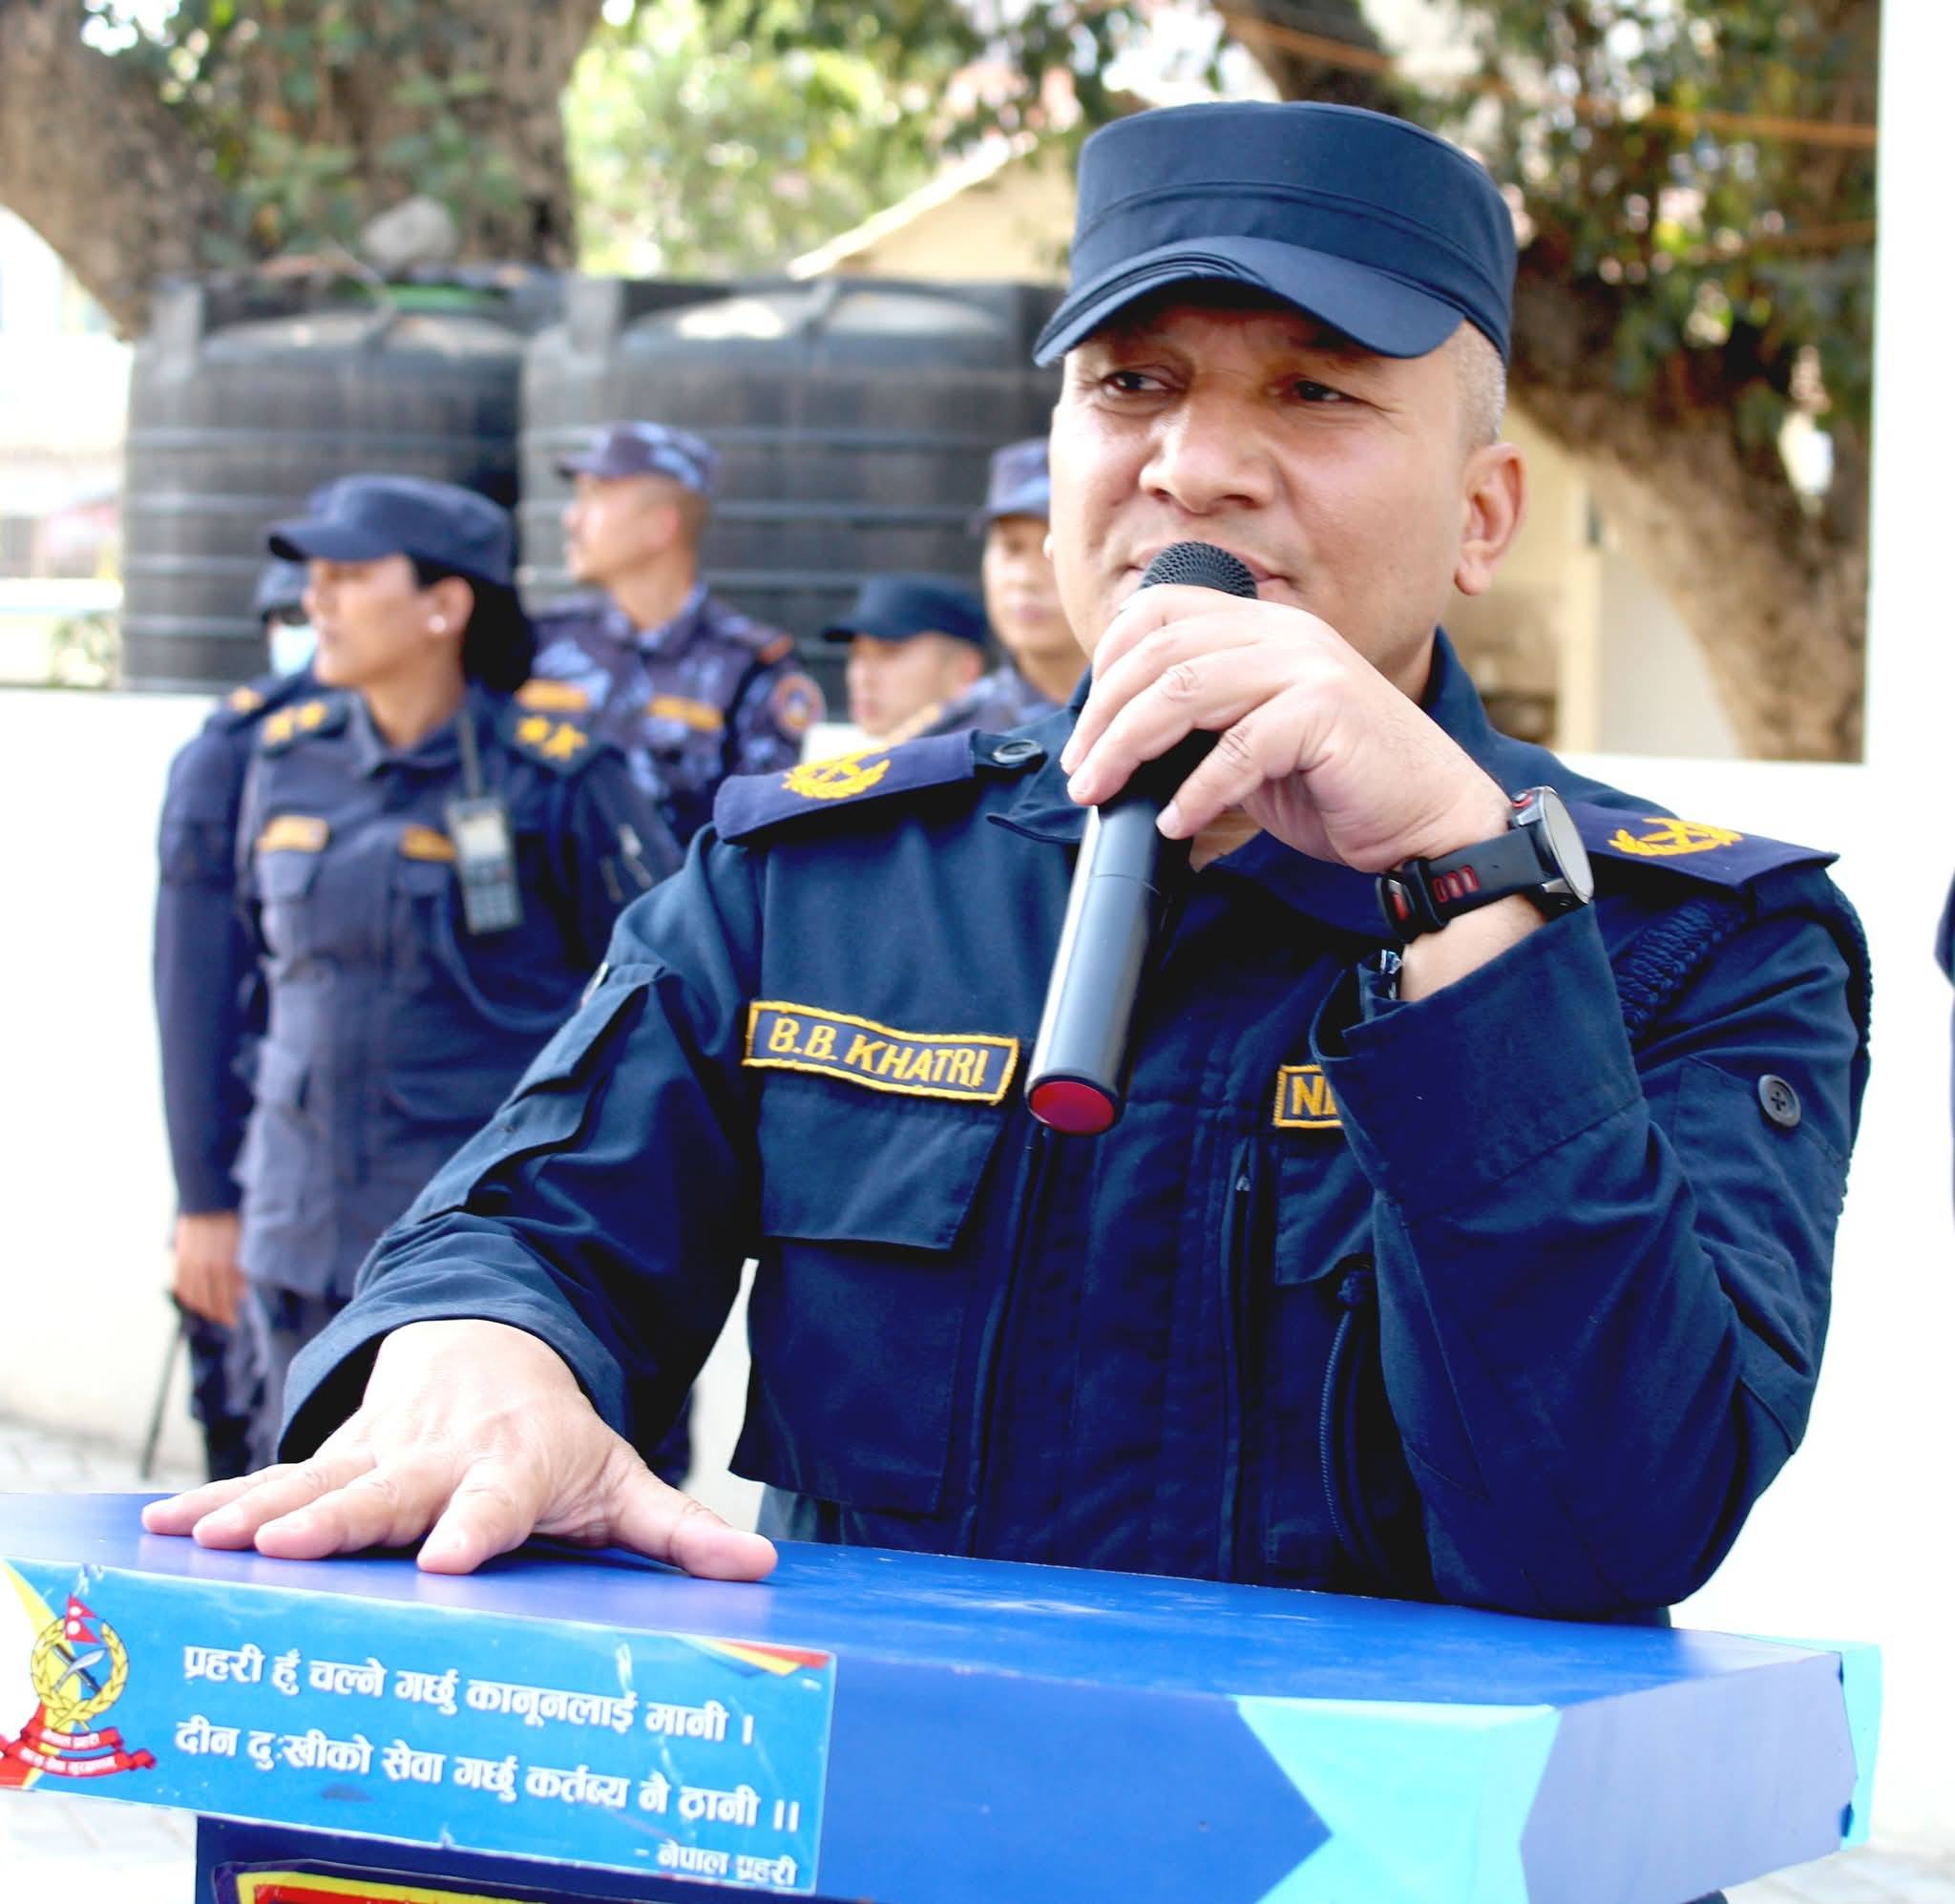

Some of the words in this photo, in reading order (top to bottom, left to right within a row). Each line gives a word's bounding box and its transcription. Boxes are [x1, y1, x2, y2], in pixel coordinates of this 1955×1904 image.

[767, 1017, 838, 1060] B.B.
[844, 1035, 990, 1088] KHATRI
[1292, 1075, 1338, 1117] N
[184, 1642, 266, 1684] प्रहरी
[272, 1648, 302, 1696] हुँ
[309, 1657, 388, 1698] चल्ने
[394, 1668, 459, 1716] गर्छु
[466, 1679, 639, 1734] कानूनलाई
[645, 1700, 730, 1742] मानी
[175, 1714, 241, 1757] दीन
[382, 1738, 447, 1784] सेवा
[452, 1755, 519, 1803] गर्छु
[679, 1783, 762, 1827] ठानी
[657, 1838, 730, 1876] नेपाल
[736, 1854, 799, 1887] प्रहरी
